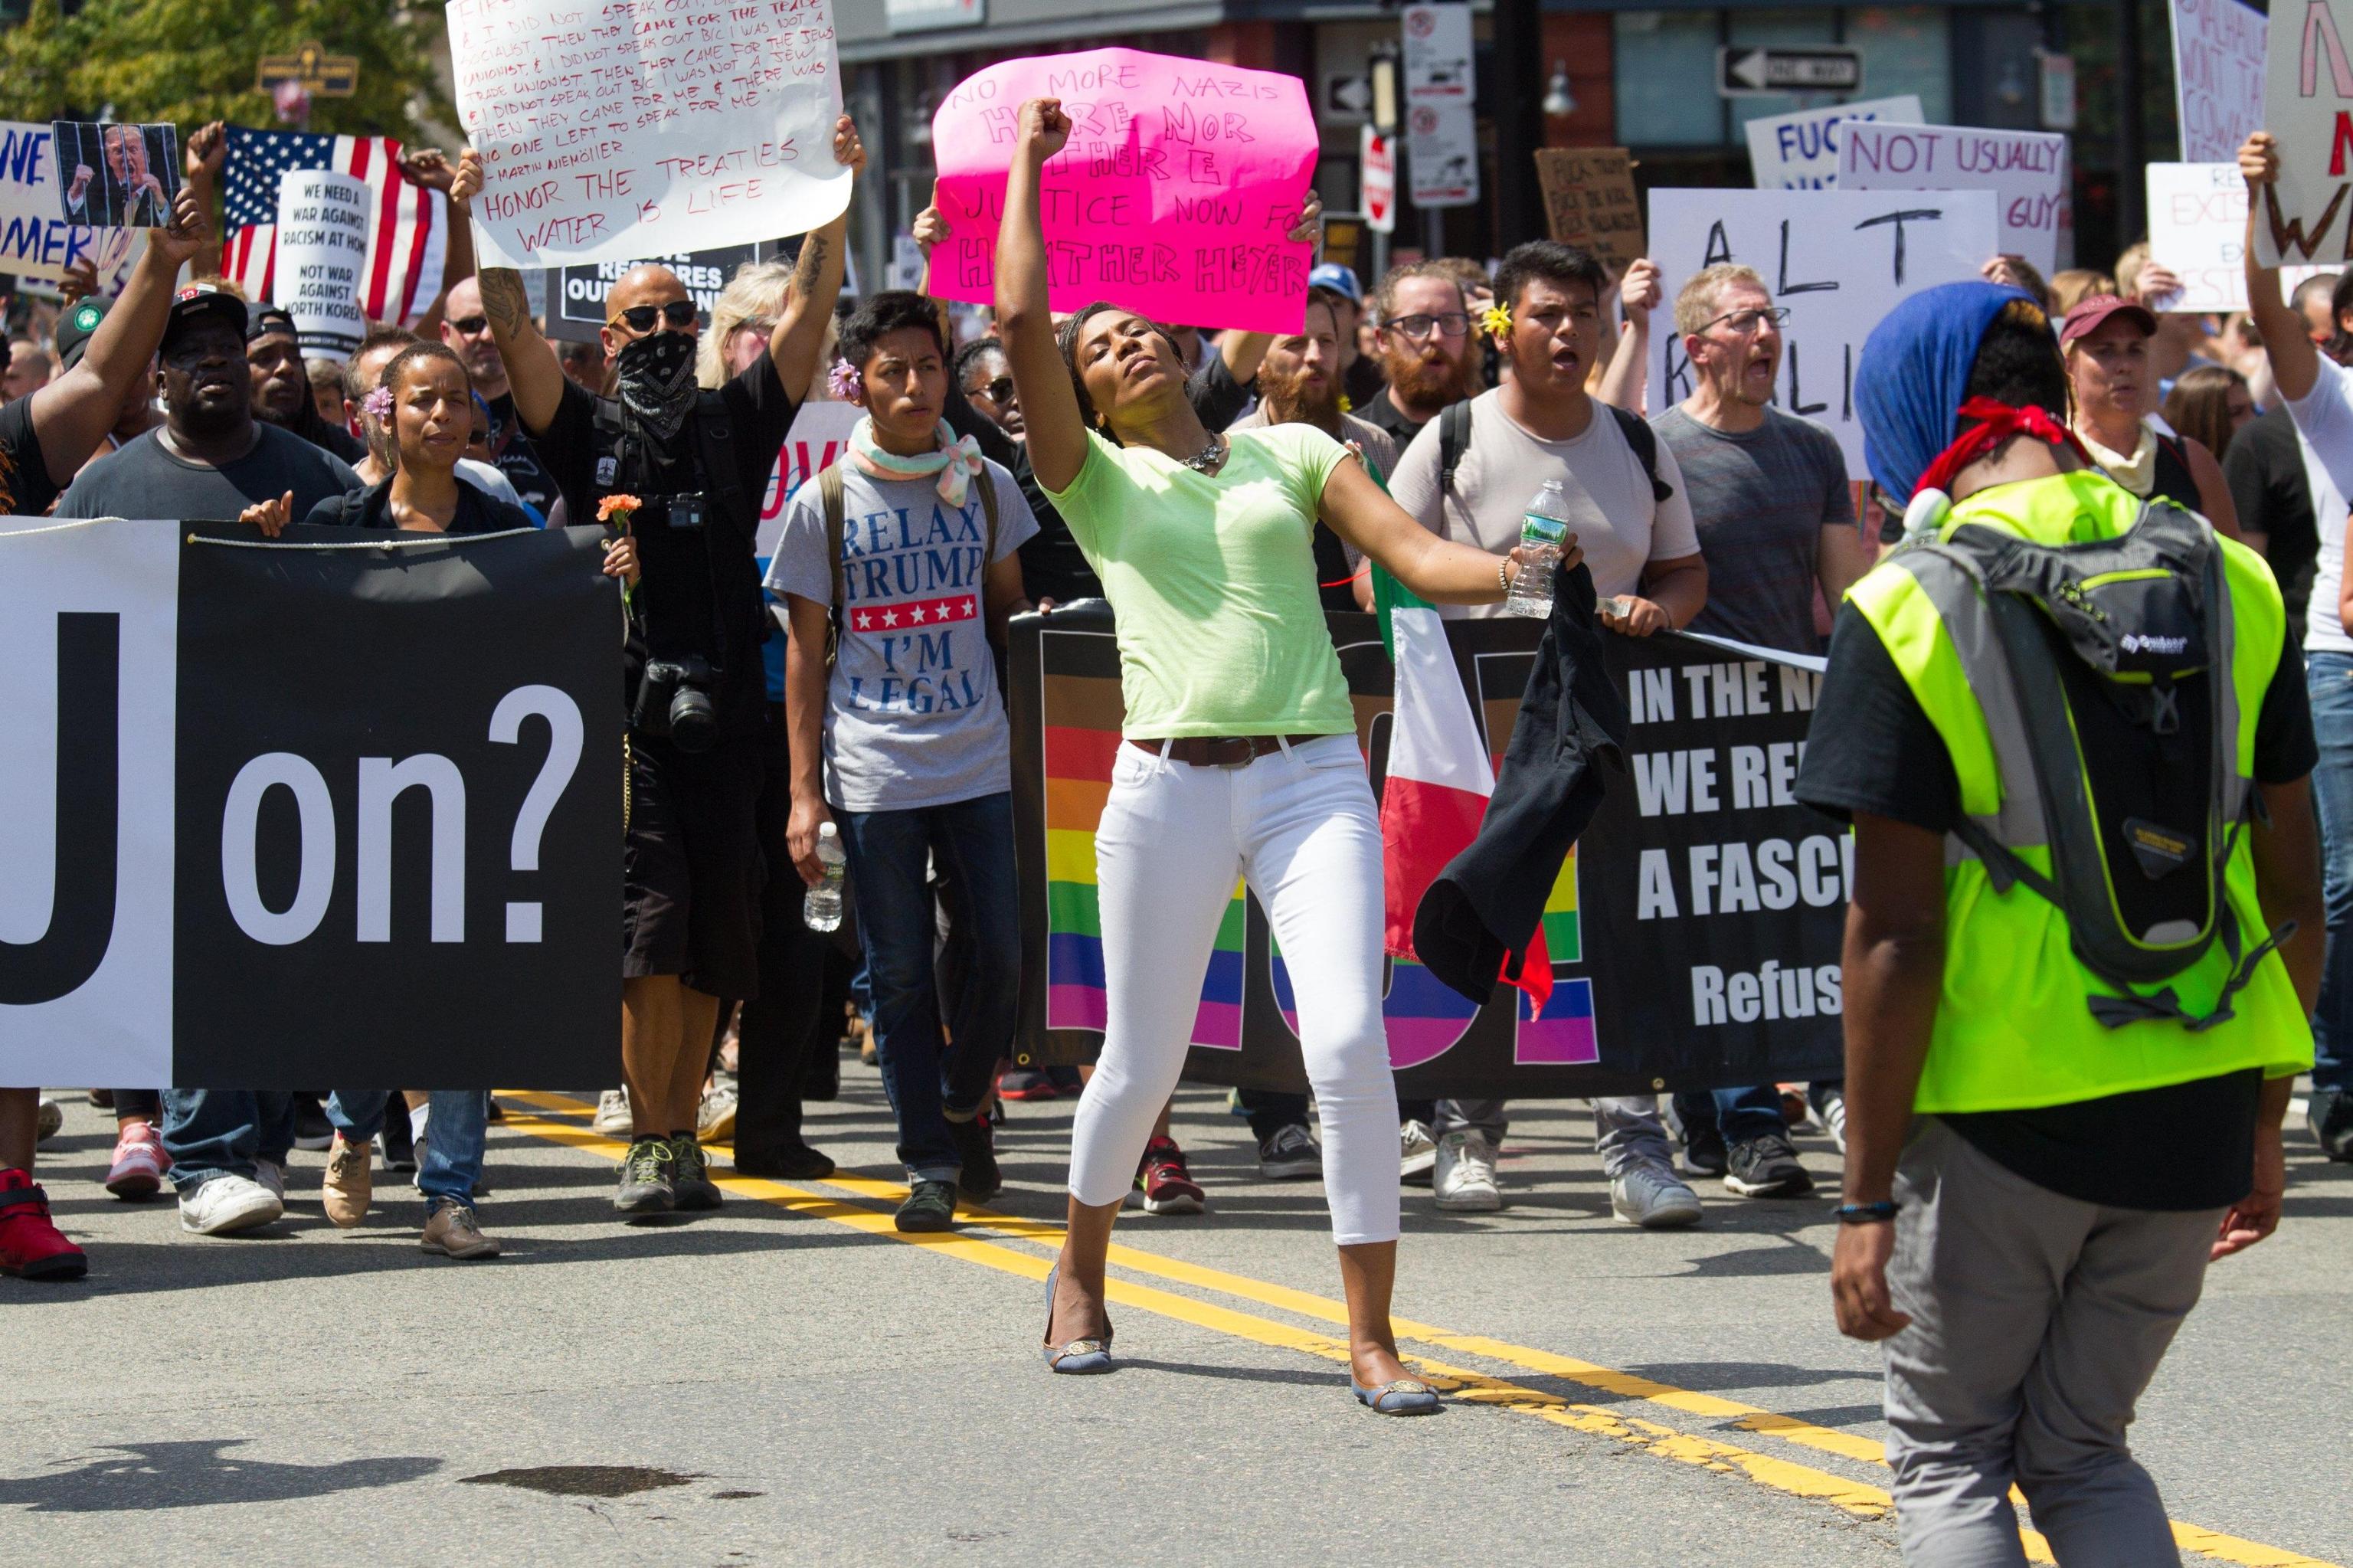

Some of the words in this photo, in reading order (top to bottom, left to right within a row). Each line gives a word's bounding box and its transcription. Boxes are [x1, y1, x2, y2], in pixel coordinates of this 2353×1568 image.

[542, 33, 586, 51] THEN
[591, 25, 622, 38] THEY
[632, 18, 676, 35] CAME
[687, 13, 721, 25] FOR
[728, 6, 760, 21] THE
[550, 12, 584, 26] NOT
[602, 2, 657, 21] SPEAK
[617, 38, 657, 54] SPEAK
[662, 32, 695, 46] OUT
[741, 21, 770, 38] WAS
[777, 14, 805, 28] NOT
[816, 11, 824, 23] A
[465, 86, 508, 106] TRADE
[591, 65, 635, 80] THEN
[638, 57, 676, 70] THEY
[683, 45, 724, 66] CAME
[731, 41, 761, 59] FOR
[767, 32, 794, 49] THE
[800, 26, 835, 44] JEWS
[550, 89, 591, 107] SPEAK
[596, 83, 623, 97] OUT
[676, 69, 706, 83] WAS
[710, 60, 739, 74] NOT
[750, 56, 761, 70] A
[770, 47, 817, 64] JEW
[951, 79, 997, 110] NO
[1048, 64, 1141, 97] MORE
[1172, 75, 1280, 100] NAZIS
[470, 121, 523, 145] THEN
[529, 113, 569, 132] THEY
[579, 101, 625, 123] CAME
[632, 93, 666, 110] FOR
[673, 87, 701, 100] ME
[732, 68, 782, 91] THERE
[792, 61, 826, 76] WAS
[980, 100, 1139, 144] HRE
[1163, 101, 1256, 146] NOR
[477, 149, 502, 166] NO
[512, 138, 545, 156] ONE
[556, 126, 597, 148] LEFT
[608, 122, 630, 135] TO
[637, 107, 681, 129] SPEAK
[689, 100, 723, 113] FOR
[1777, 112, 1875, 162] FUC
[1851, 131, 1941, 174] NOT
[1956, 135, 2063, 175] USUALLY
[304, 183, 321, 198] WE
[324, 184, 352, 204] NEED
[353, 191, 360, 206] A
[484, 180, 565, 221] HONOR
[575, 169, 637, 199] THE
[656, 138, 799, 183] TREATIES
[293, 208, 318, 222] WAR
[321, 208, 364, 231] AGAINST
[517, 214, 610, 252] WATER
[636, 198, 663, 224] IS
[687, 179, 764, 214] LIFE
[965, 186, 1131, 228] JUTICE
[1174, 194, 1244, 227] NOW
[1264, 203, 1302, 231] FO
[2007, 191, 2061, 231] GUY
[283, 231, 326, 247] RACISM
[328, 231, 344, 247] AT
[1703, 208, 1943, 296] ALT
[299, 265, 324, 280] NOT
[328, 266, 354, 283] WAR
[958, 237, 1181, 290] HTHER
[1194, 244, 1308, 298] HEYER
[299, 283, 351, 301] AGAINST
[326, 302, 360, 322] KOREA
[842, 502, 982, 561] RELAX
[843, 545, 984, 601] TRUMP
[882, 630, 954, 673] I'M
[848, 669, 984, 714] LEGAL
[1628, 667, 1674, 725] IN
[1682, 661, 1771, 719] THE
[1631, 748, 1720, 817] WE
[221, 684, 585, 946] on?
[1638, 849, 1679, 920] A
[1689, 835, 1856, 916] FASCI
[1691, 959, 1844, 1026] Refus
